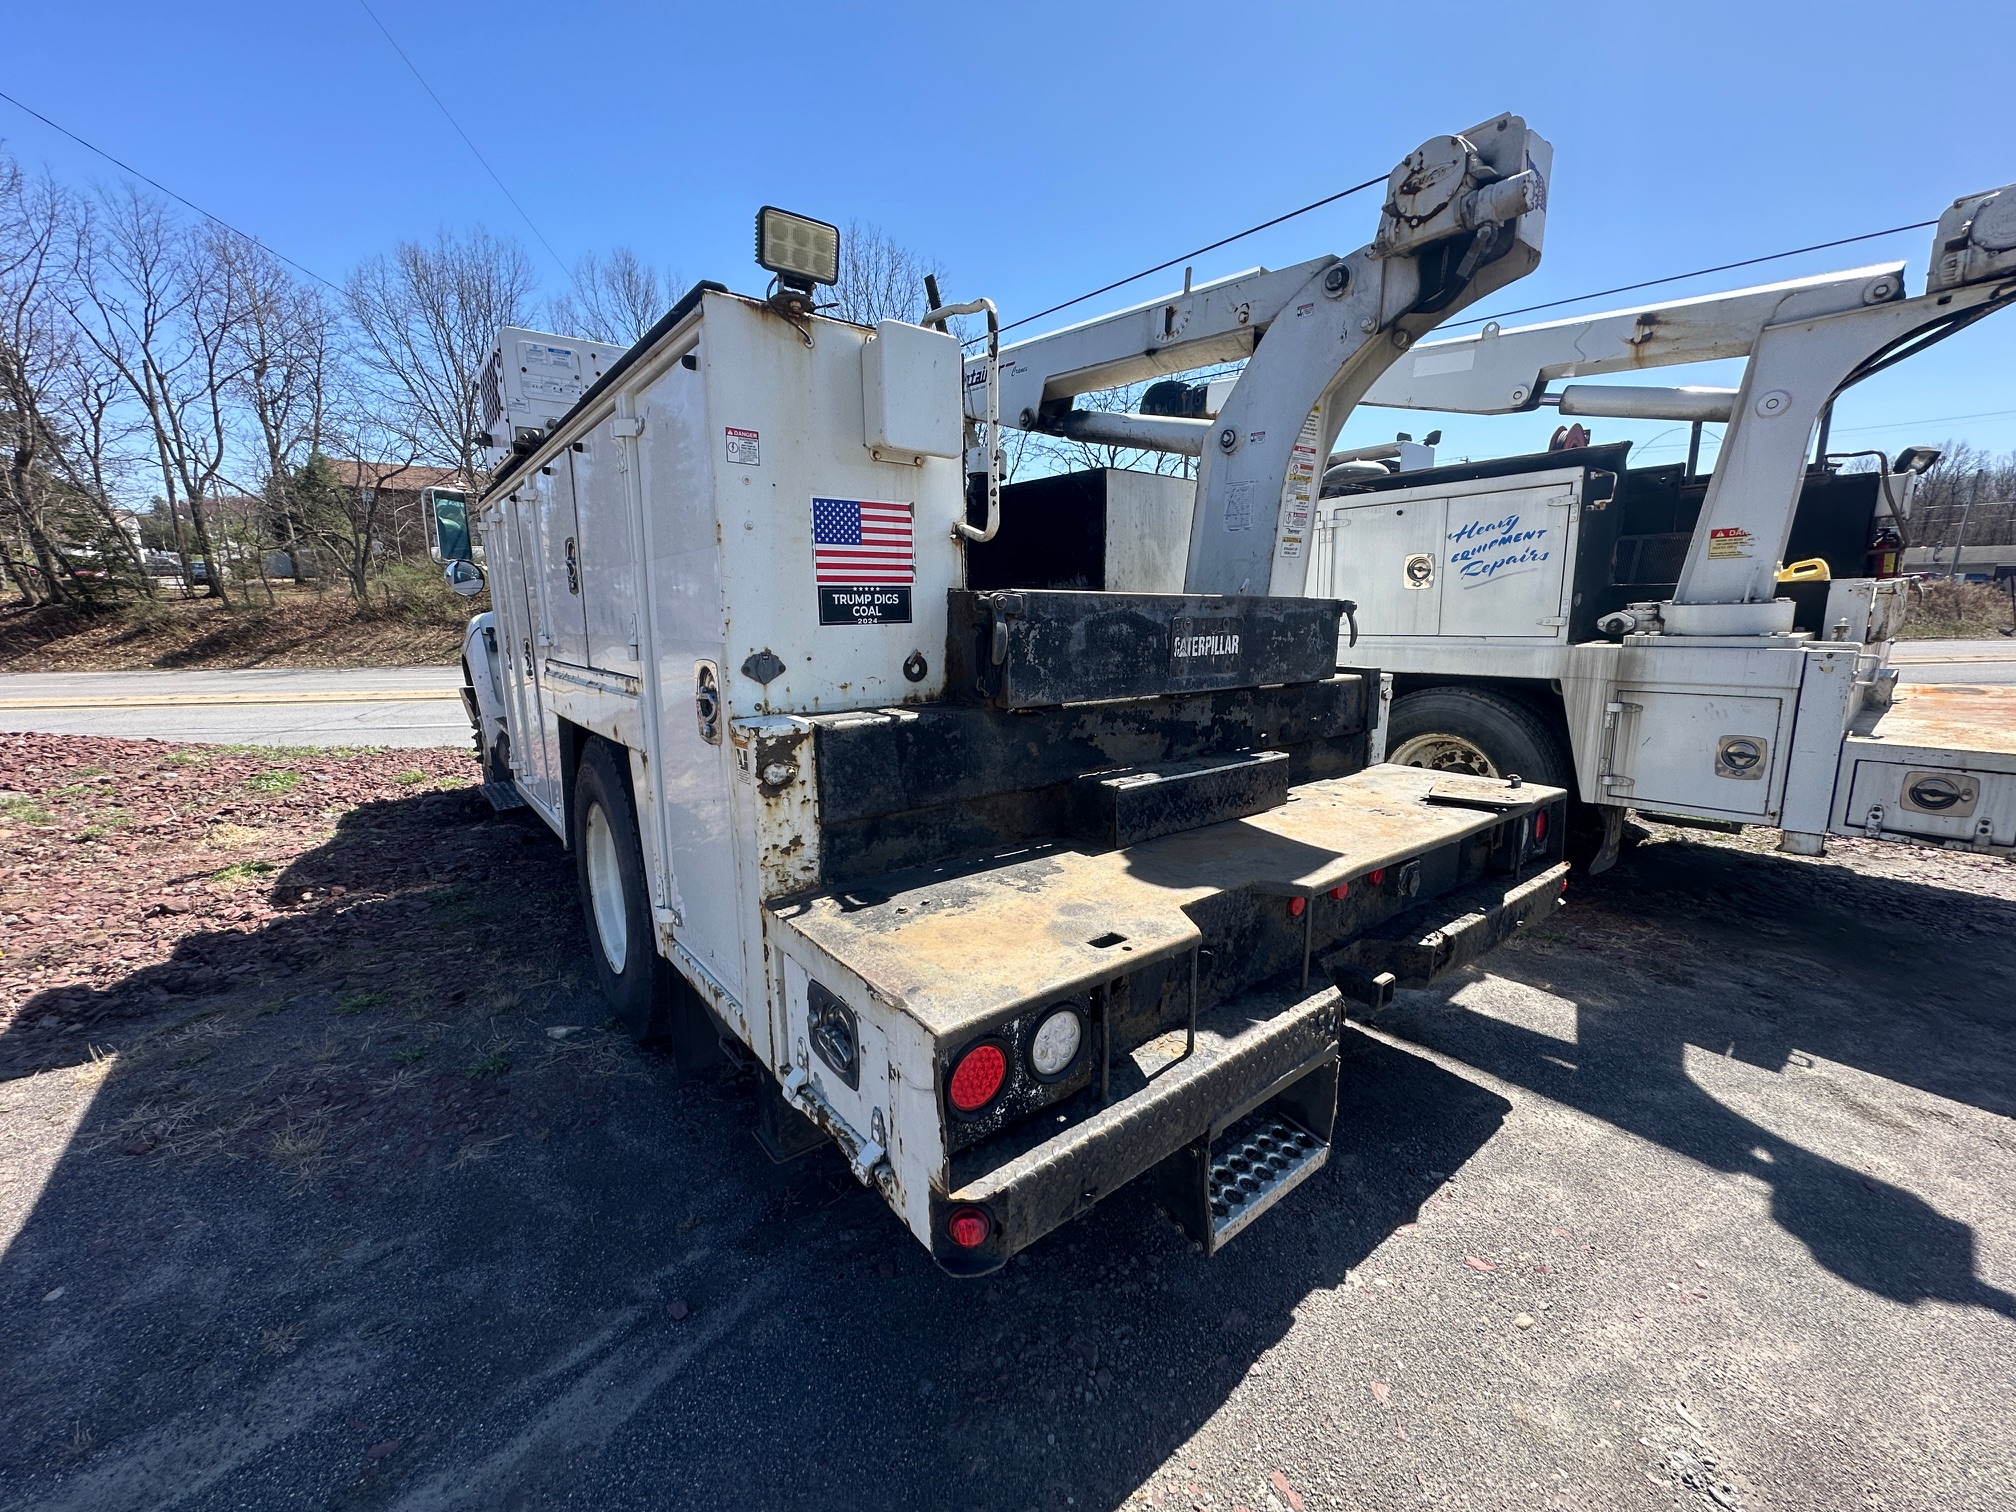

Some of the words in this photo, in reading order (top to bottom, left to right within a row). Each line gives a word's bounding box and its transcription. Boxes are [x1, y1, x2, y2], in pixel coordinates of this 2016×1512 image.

[733, 430, 758, 438] DANGER
[1447, 514, 1520, 543] Heavy
[1451, 529, 1547, 563] EQUIPMENT
[1460, 546, 1549, 580] Repairs
[832, 593, 872, 605] TRUMP
[874, 593, 899, 604] DIGS
[852, 605, 882, 617] COAL
[1173, 634, 1240, 658] CATERPILLAR
